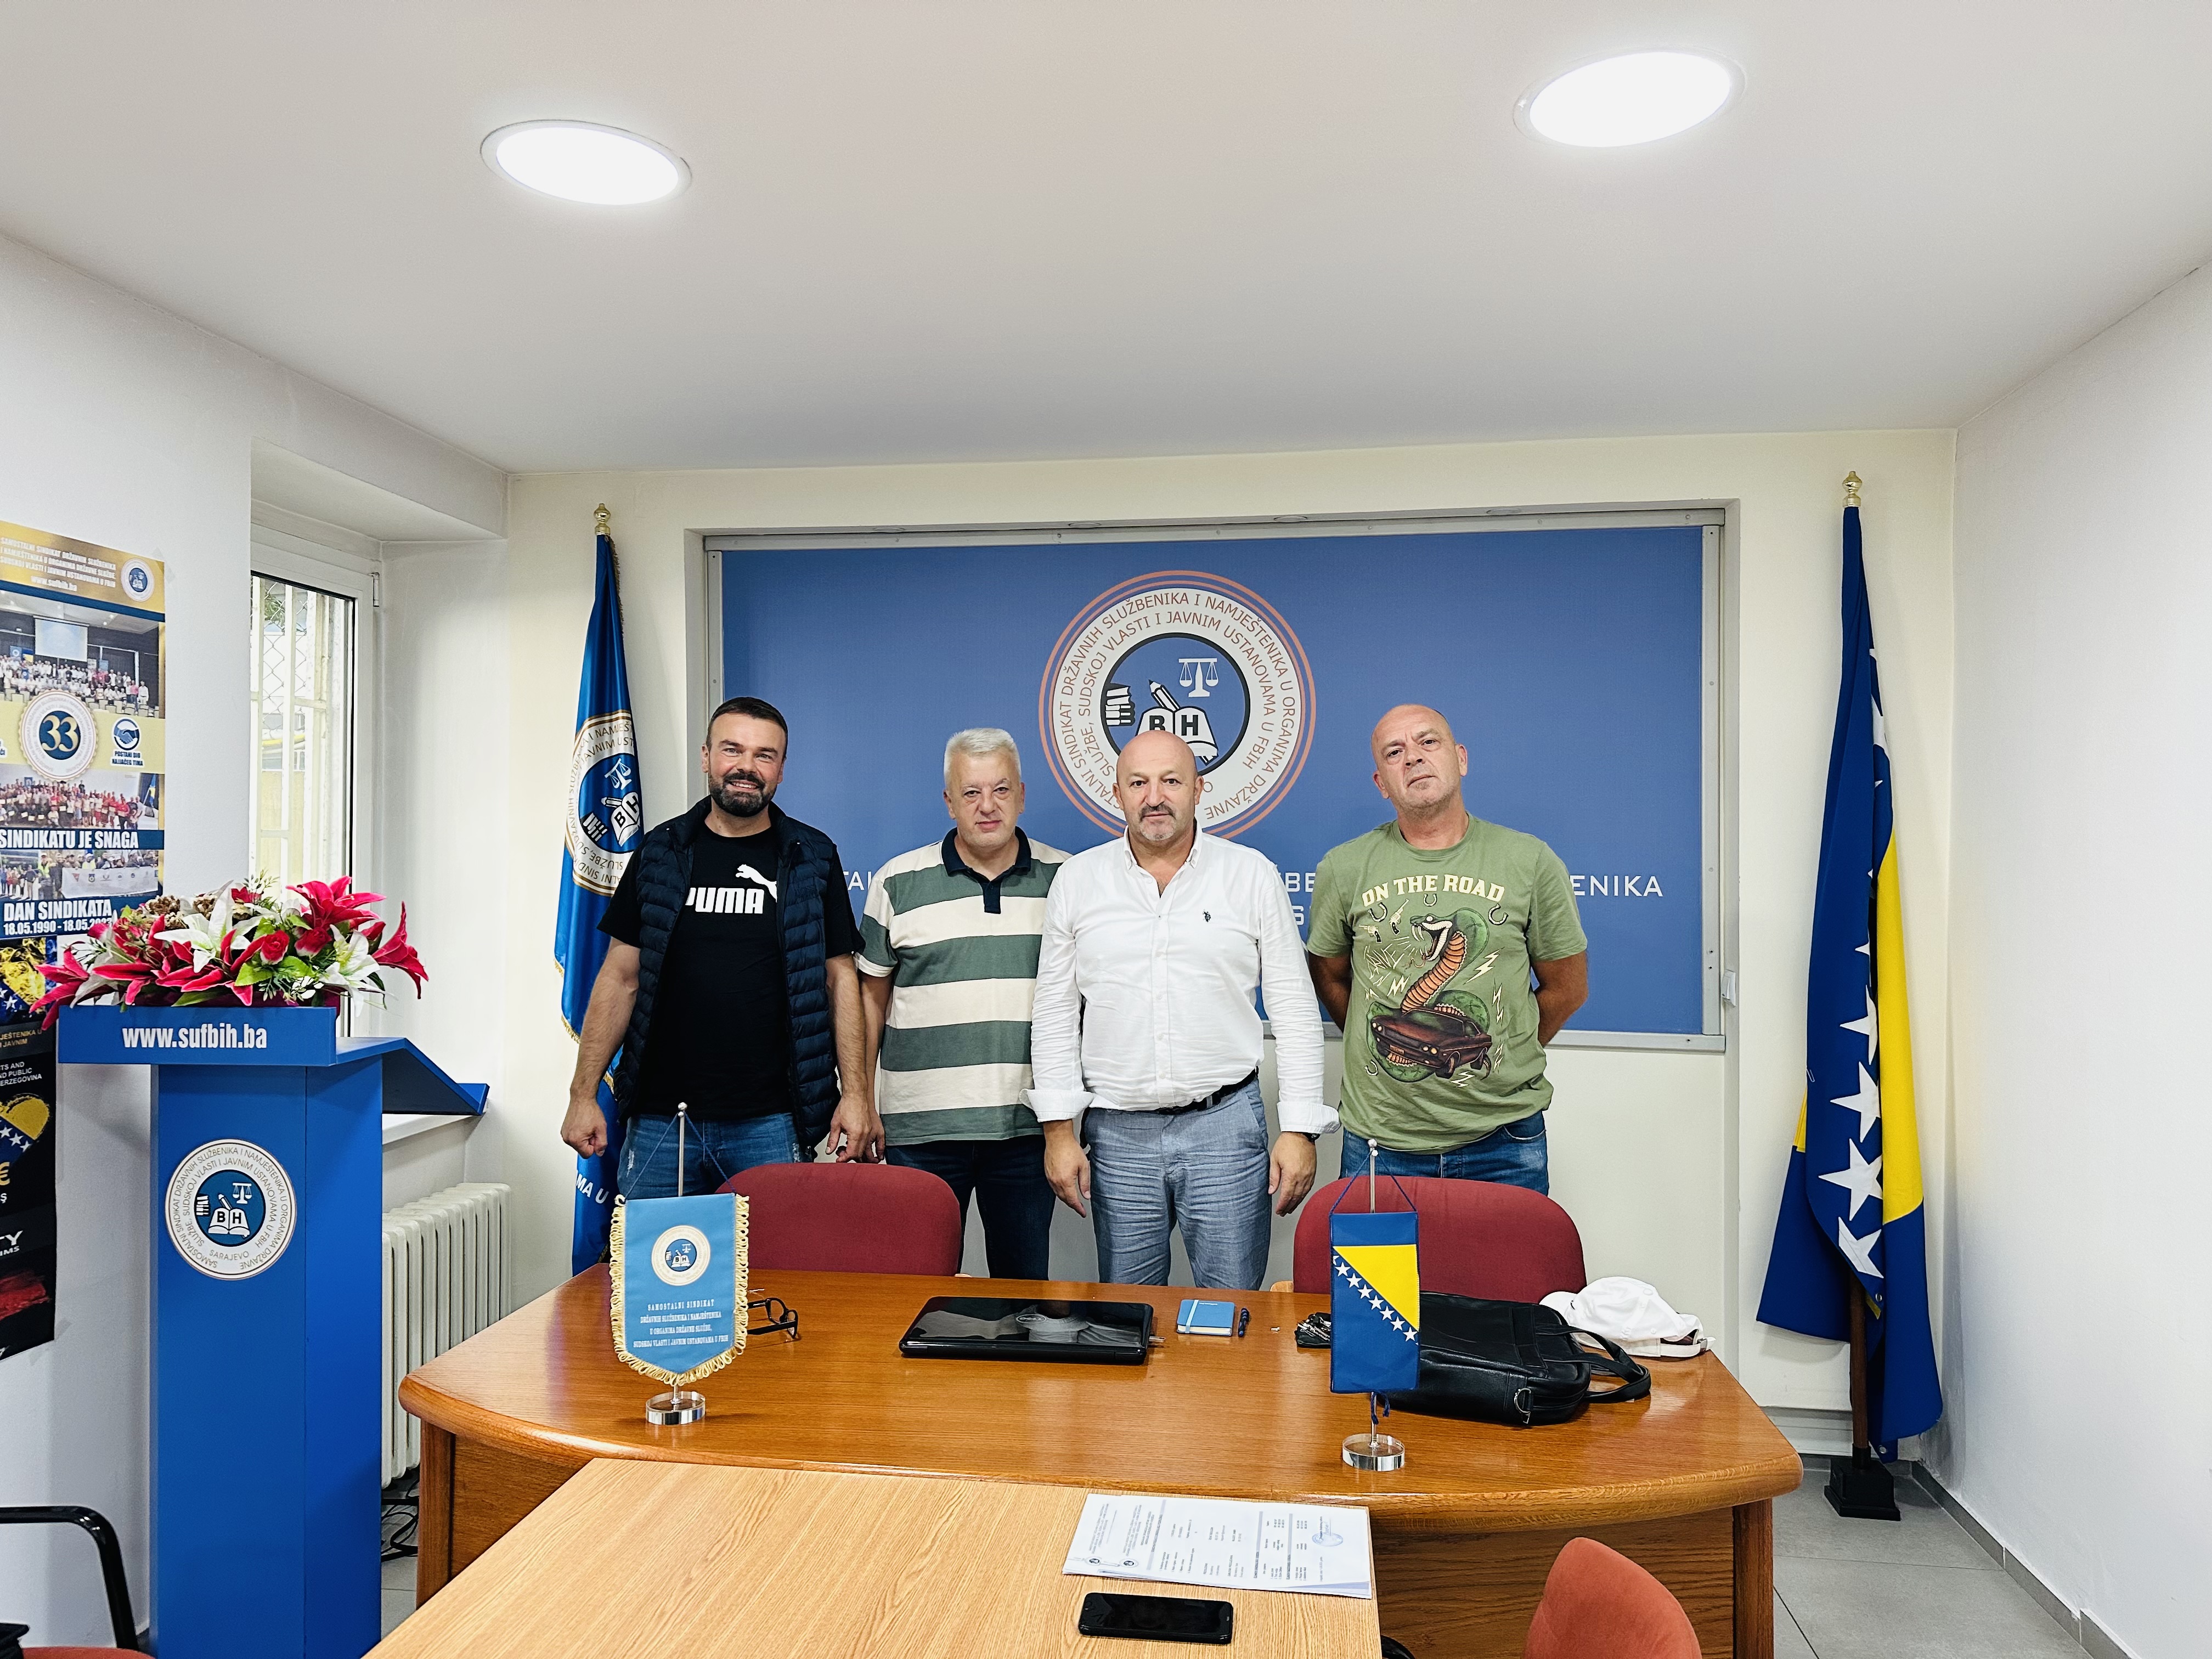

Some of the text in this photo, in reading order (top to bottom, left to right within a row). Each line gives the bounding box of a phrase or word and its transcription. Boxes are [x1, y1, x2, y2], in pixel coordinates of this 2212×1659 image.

[1102, 592, 1189, 629] SLUŽBENIKA
[1194, 594, 1200, 606] I
[1155, 613, 1161, 625] I
[1166, 611, 1221, 631] JAVNIM
[1103, 616, 1150, 651] VLASTI
[1205, 596, 1288, 678] NAMJEŠTENIKA
[1061, 627, 1103, 696] DRŽAVNIH
[1223, 625, 1276, 716] USTANOVAMA
[1079, 652, 1107, 716] SUDSKOJ
[1280, 680, 1294, 691] U
[42, 715, 78, 752] 33
[1059, 701, 1086, 769] SINDIKAT
[1261, 722, 1274, 732] U
[1262, 697, 1295, 773] ORGANIMA
[582, 740, 615, 764] JAVNIM
[1243, 736, 1269, 769] FBIH
[1204, 774, 1266, 819] DRŽAVNE
[0, 829, 139, 849] SINDIKATU JE SNAGA
[1362, 874, 1505, 907] ON THE ROAD
[4, 899, 112, 921] DAN SINDIKATA
[3, 921, 57, 935] 18.05.1990
[122, 1023, 267, 1048] www.sufbih.ba
[0, 1074, 42, 1086] ERZEGOVINA
[8, 1068, 32, 1077] PUBLIC
[595, 1188, 609, 1204] U
[209, 1250, 249, 1261] SARAJEVO
[647, 1299, 714, 1311] SAMOSTALNI SINDIKAT
